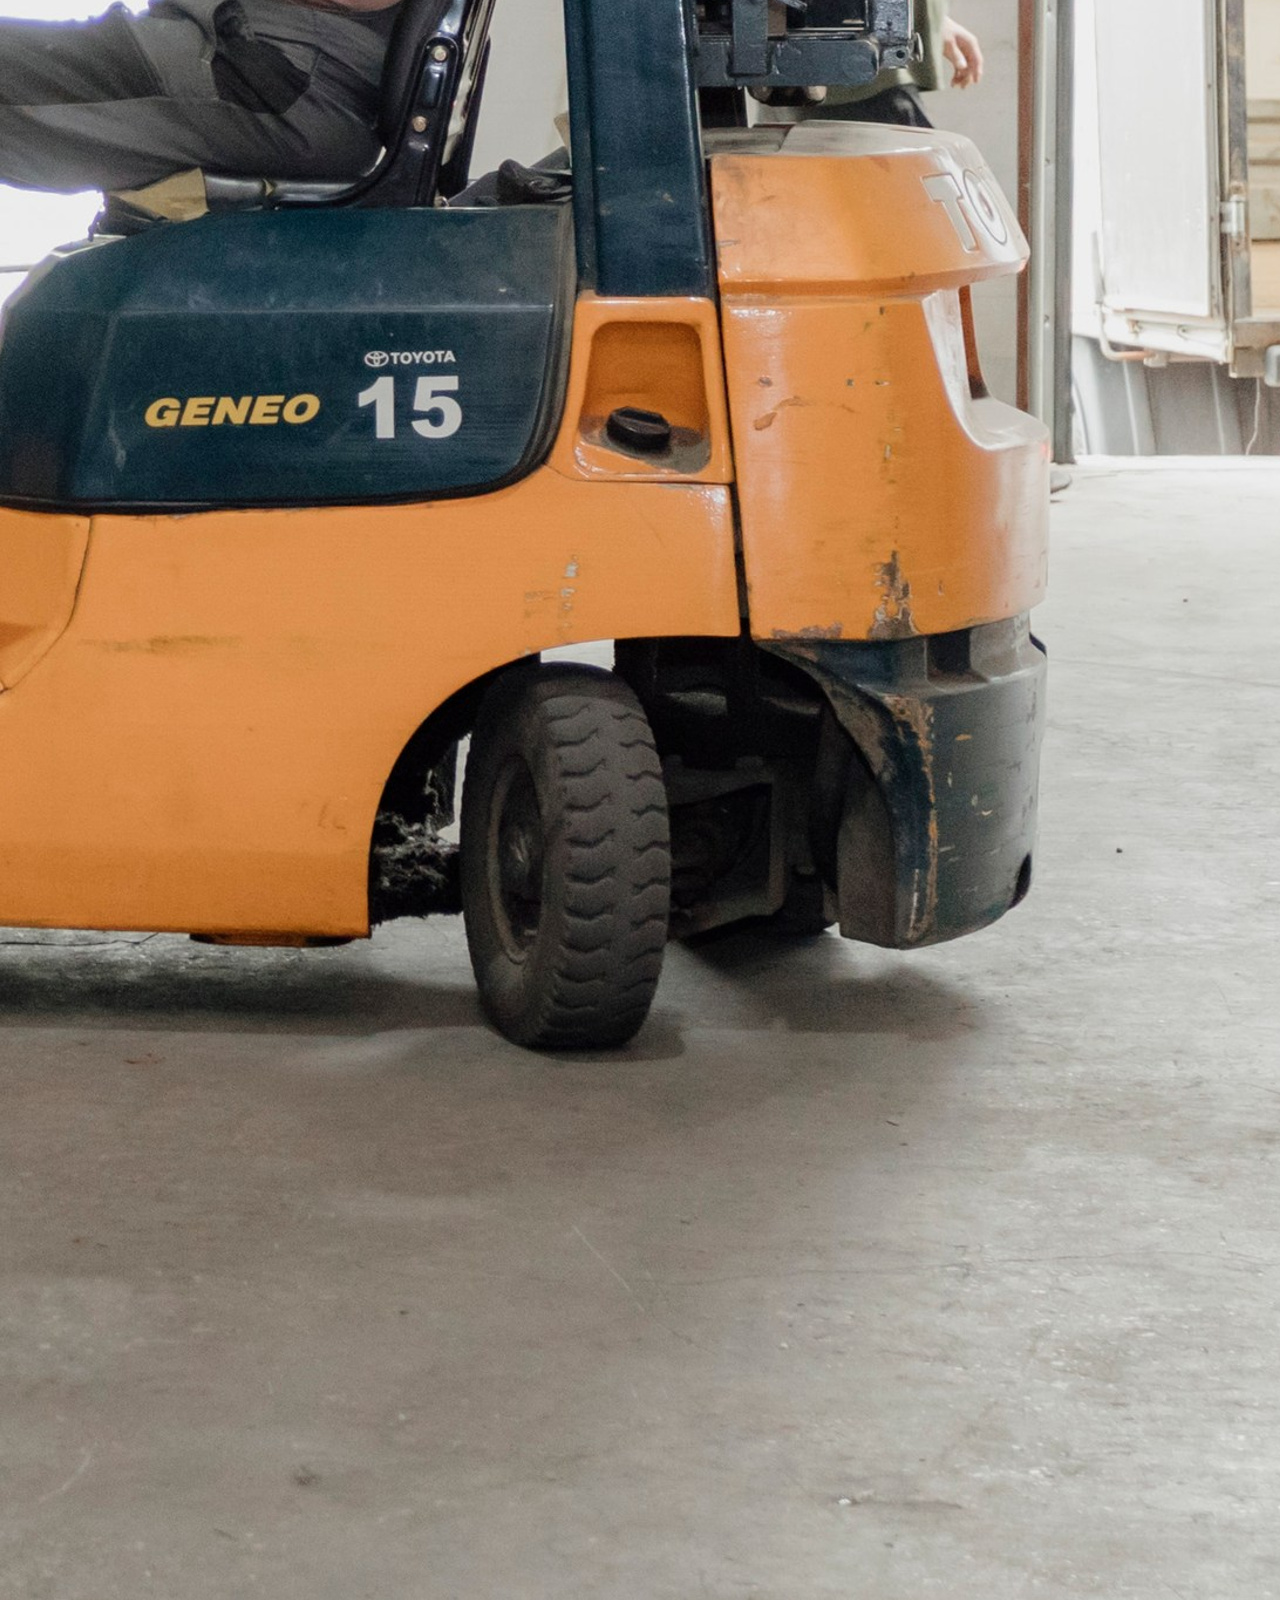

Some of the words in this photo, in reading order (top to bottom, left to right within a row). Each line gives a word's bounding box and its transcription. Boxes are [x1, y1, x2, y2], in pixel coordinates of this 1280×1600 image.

[389, 350, 457, 365] TOYOTA
[144, 393, 321, 428] GENEO
[358, 375, 463, 439] 15
